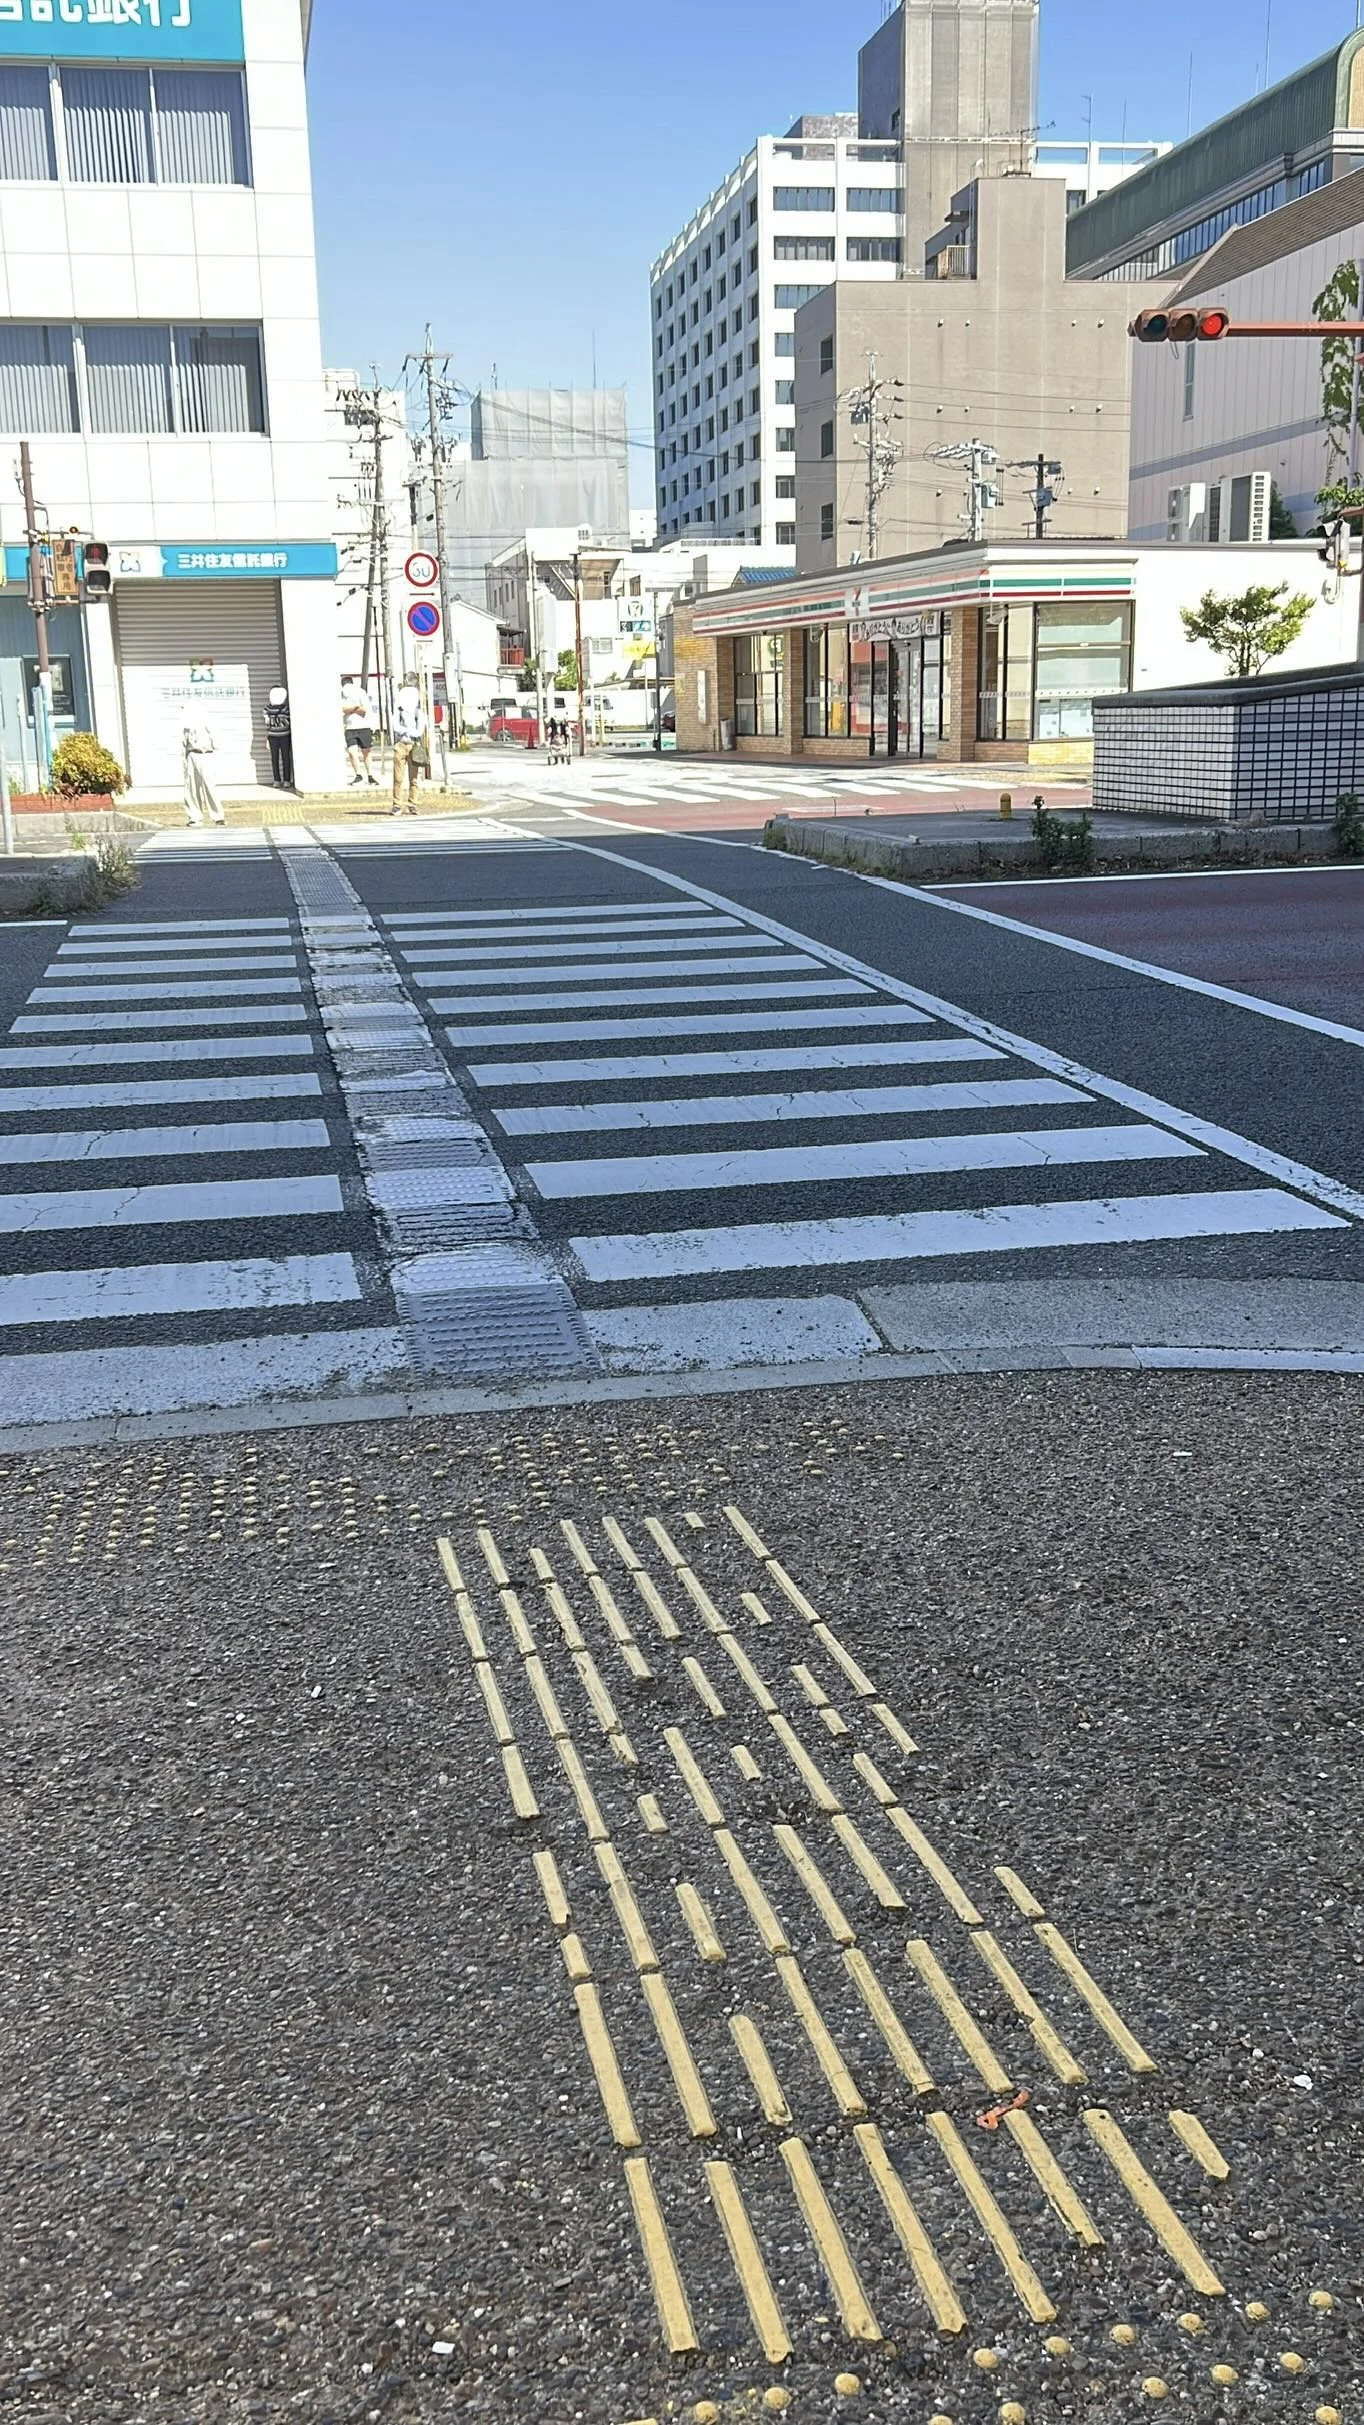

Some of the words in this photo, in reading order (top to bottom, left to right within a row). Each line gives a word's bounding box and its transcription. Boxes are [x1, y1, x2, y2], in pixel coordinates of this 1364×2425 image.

[177, 553, 288, 569] 三井住友信託銀行
